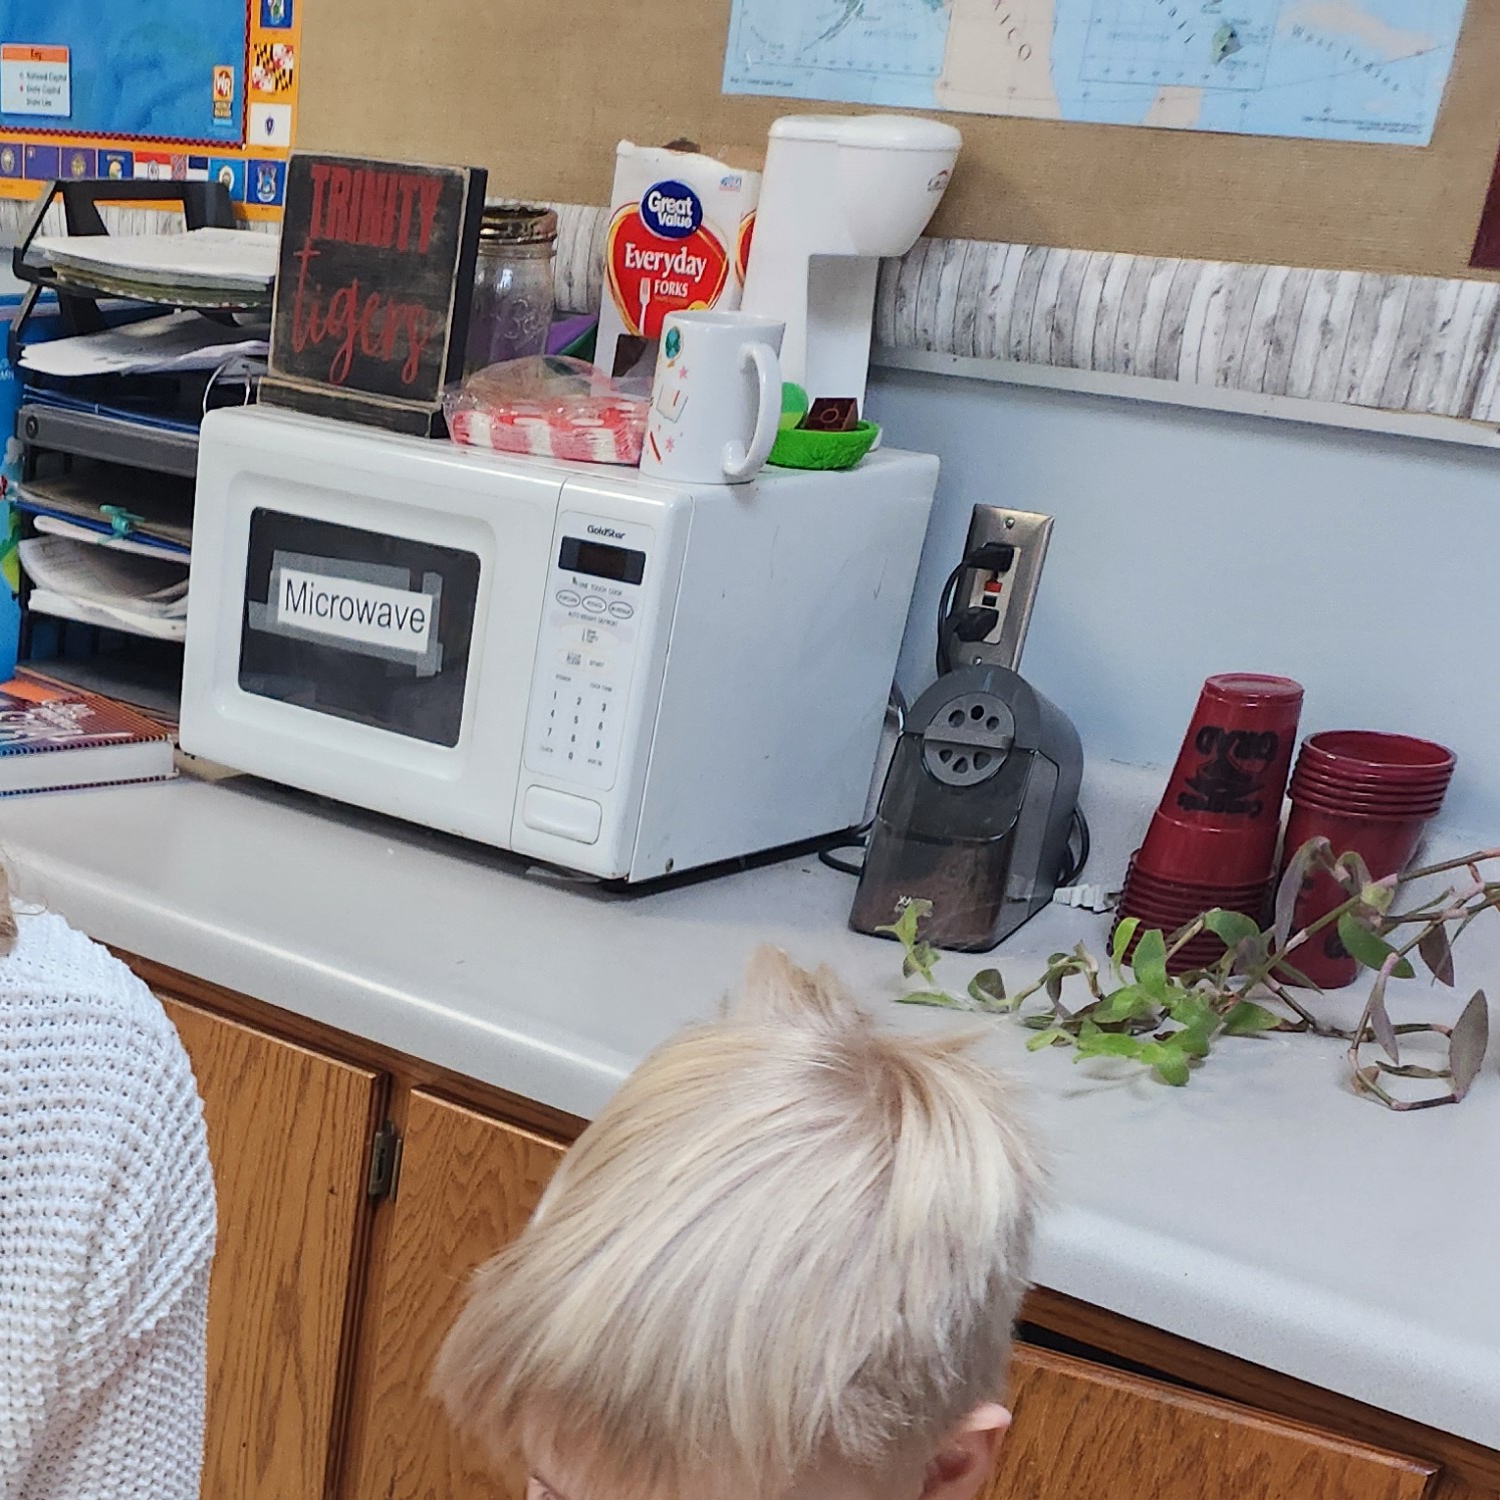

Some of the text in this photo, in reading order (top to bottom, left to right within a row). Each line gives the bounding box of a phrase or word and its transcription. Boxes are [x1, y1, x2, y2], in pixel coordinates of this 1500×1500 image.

[310, 163, 443, 255] TRINITY
[648, 190, 693, 215] Great
[657, 212, 693, 228] Value
[624, 242, 707, 283] Everyday
[654, 279, 688, 297] FORKS
[293, 236, 439, 385] tigers
[587, 524, 626, 539] GoldStar
[285, 578, 425, 634] Microwave
